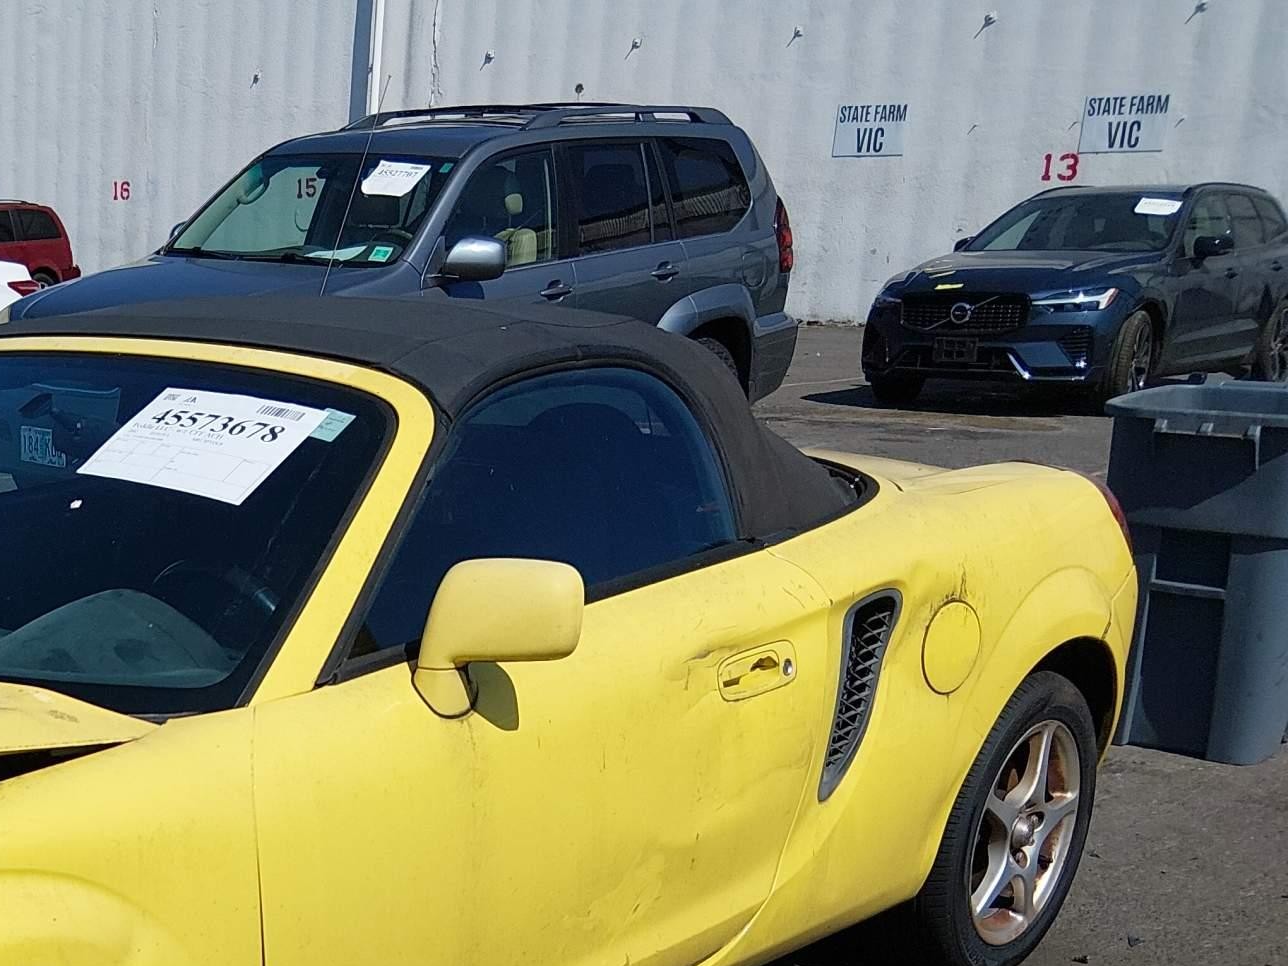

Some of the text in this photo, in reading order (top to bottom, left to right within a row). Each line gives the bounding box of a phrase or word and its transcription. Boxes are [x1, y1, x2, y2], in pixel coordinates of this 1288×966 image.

[839, 103, 908, 123] STATE FARM
[1086, 94, 1169, 117] STATE FARM
[855, 127, 885, 154] VIC
[1106, 121, 1141, 149] VIC
[1041, 153, 1079, 182] 13
[113, 181, 130, 200] 16
[296, 177, 317, 199] 15
[151, 407, 286, 443] 45573678
